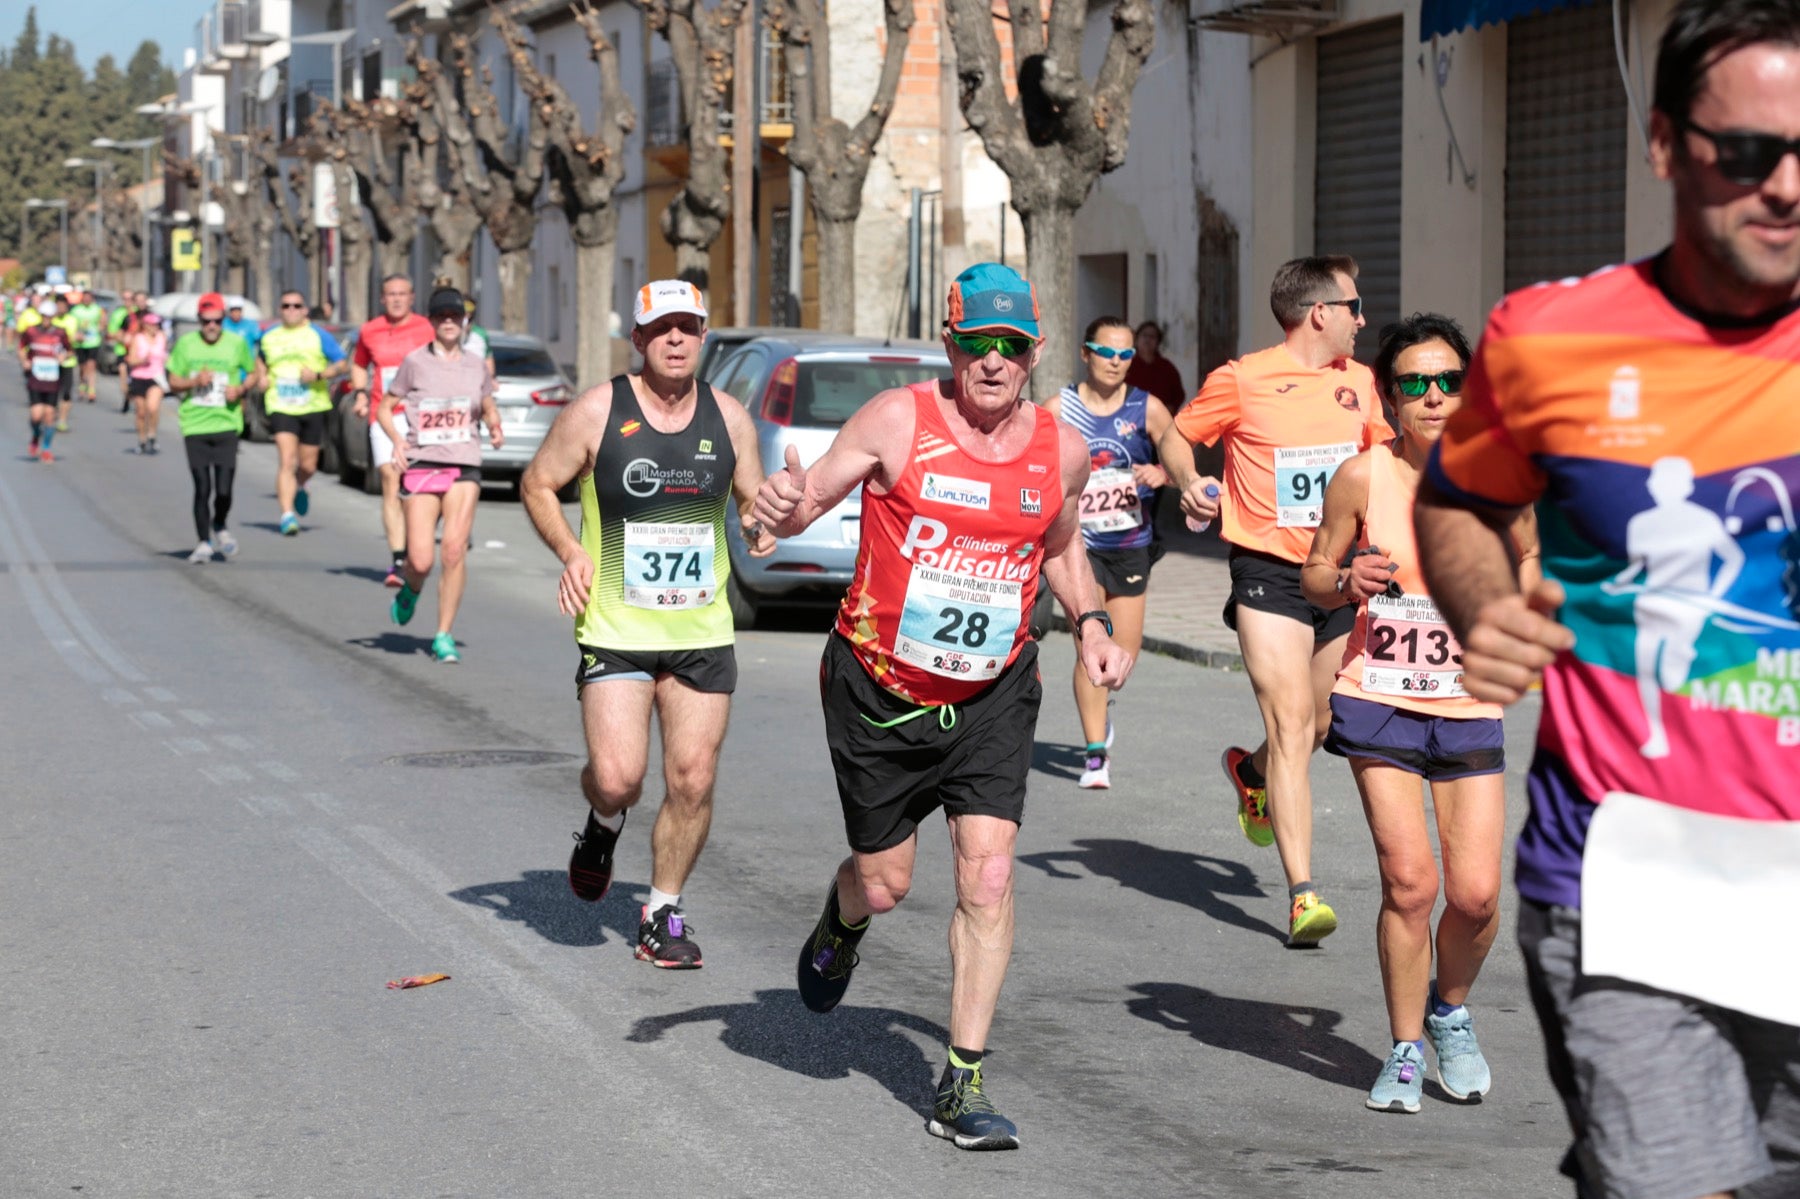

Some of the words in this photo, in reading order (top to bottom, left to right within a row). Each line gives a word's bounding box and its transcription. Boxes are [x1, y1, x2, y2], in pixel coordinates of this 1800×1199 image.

[422, 411, 468, 429] 2267
[650, 469, 695, 478] MasFoto
[1081, 486, 1138, 514] 2226
[650, 526, 666, 535] GRAN
[953, 535, 1008, 554] Clínicas
[642, 551, 702, 582] 374
[920, 570, 941, 584] XXXIII
[941, 574, 962, 587] GRAN
[963, 578, 989, 591] PREMIO
[989, 582, 999, 593] DE
[1397, 597, 1416, 609] GRAN
[933, 606, 990, 648] 28
[1372, 624, 1463, 666] 213
